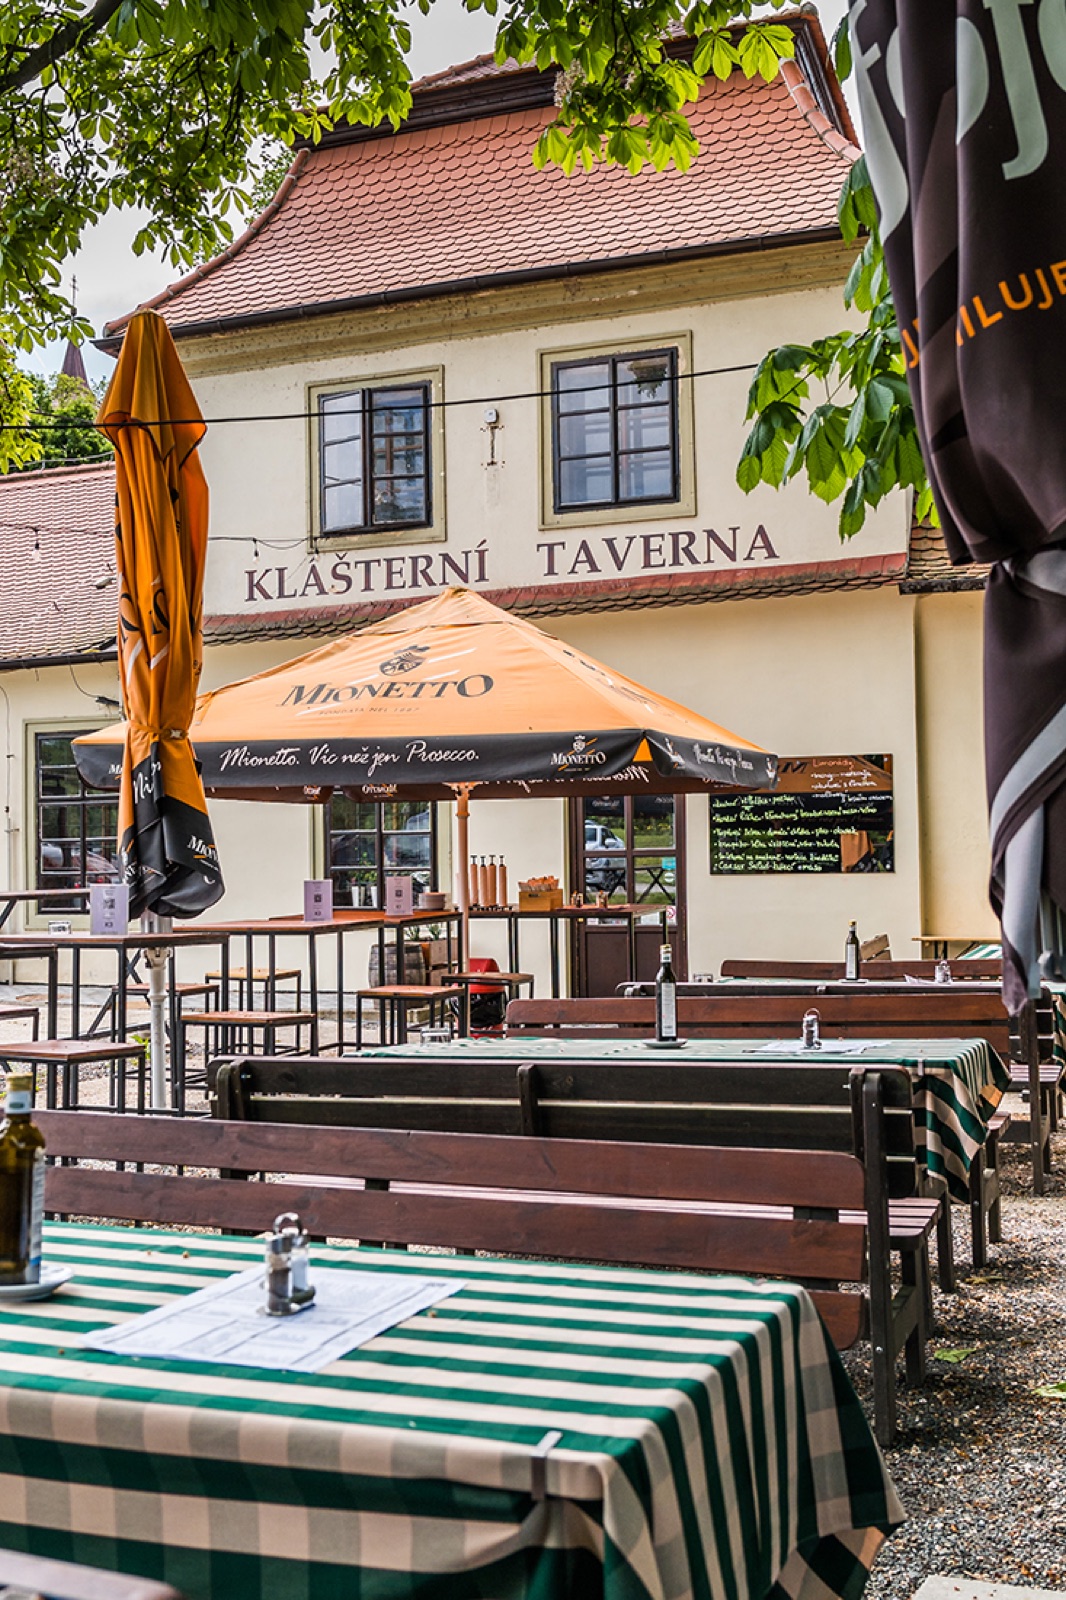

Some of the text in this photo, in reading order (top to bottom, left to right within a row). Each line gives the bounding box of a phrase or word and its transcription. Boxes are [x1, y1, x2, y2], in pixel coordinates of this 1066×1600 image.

[245, 524, 780, 601] KLÁŠTERNÍ TAVERNA
[219, 739, 480, 777] Mionetto. Víc než jen Prosecco.
